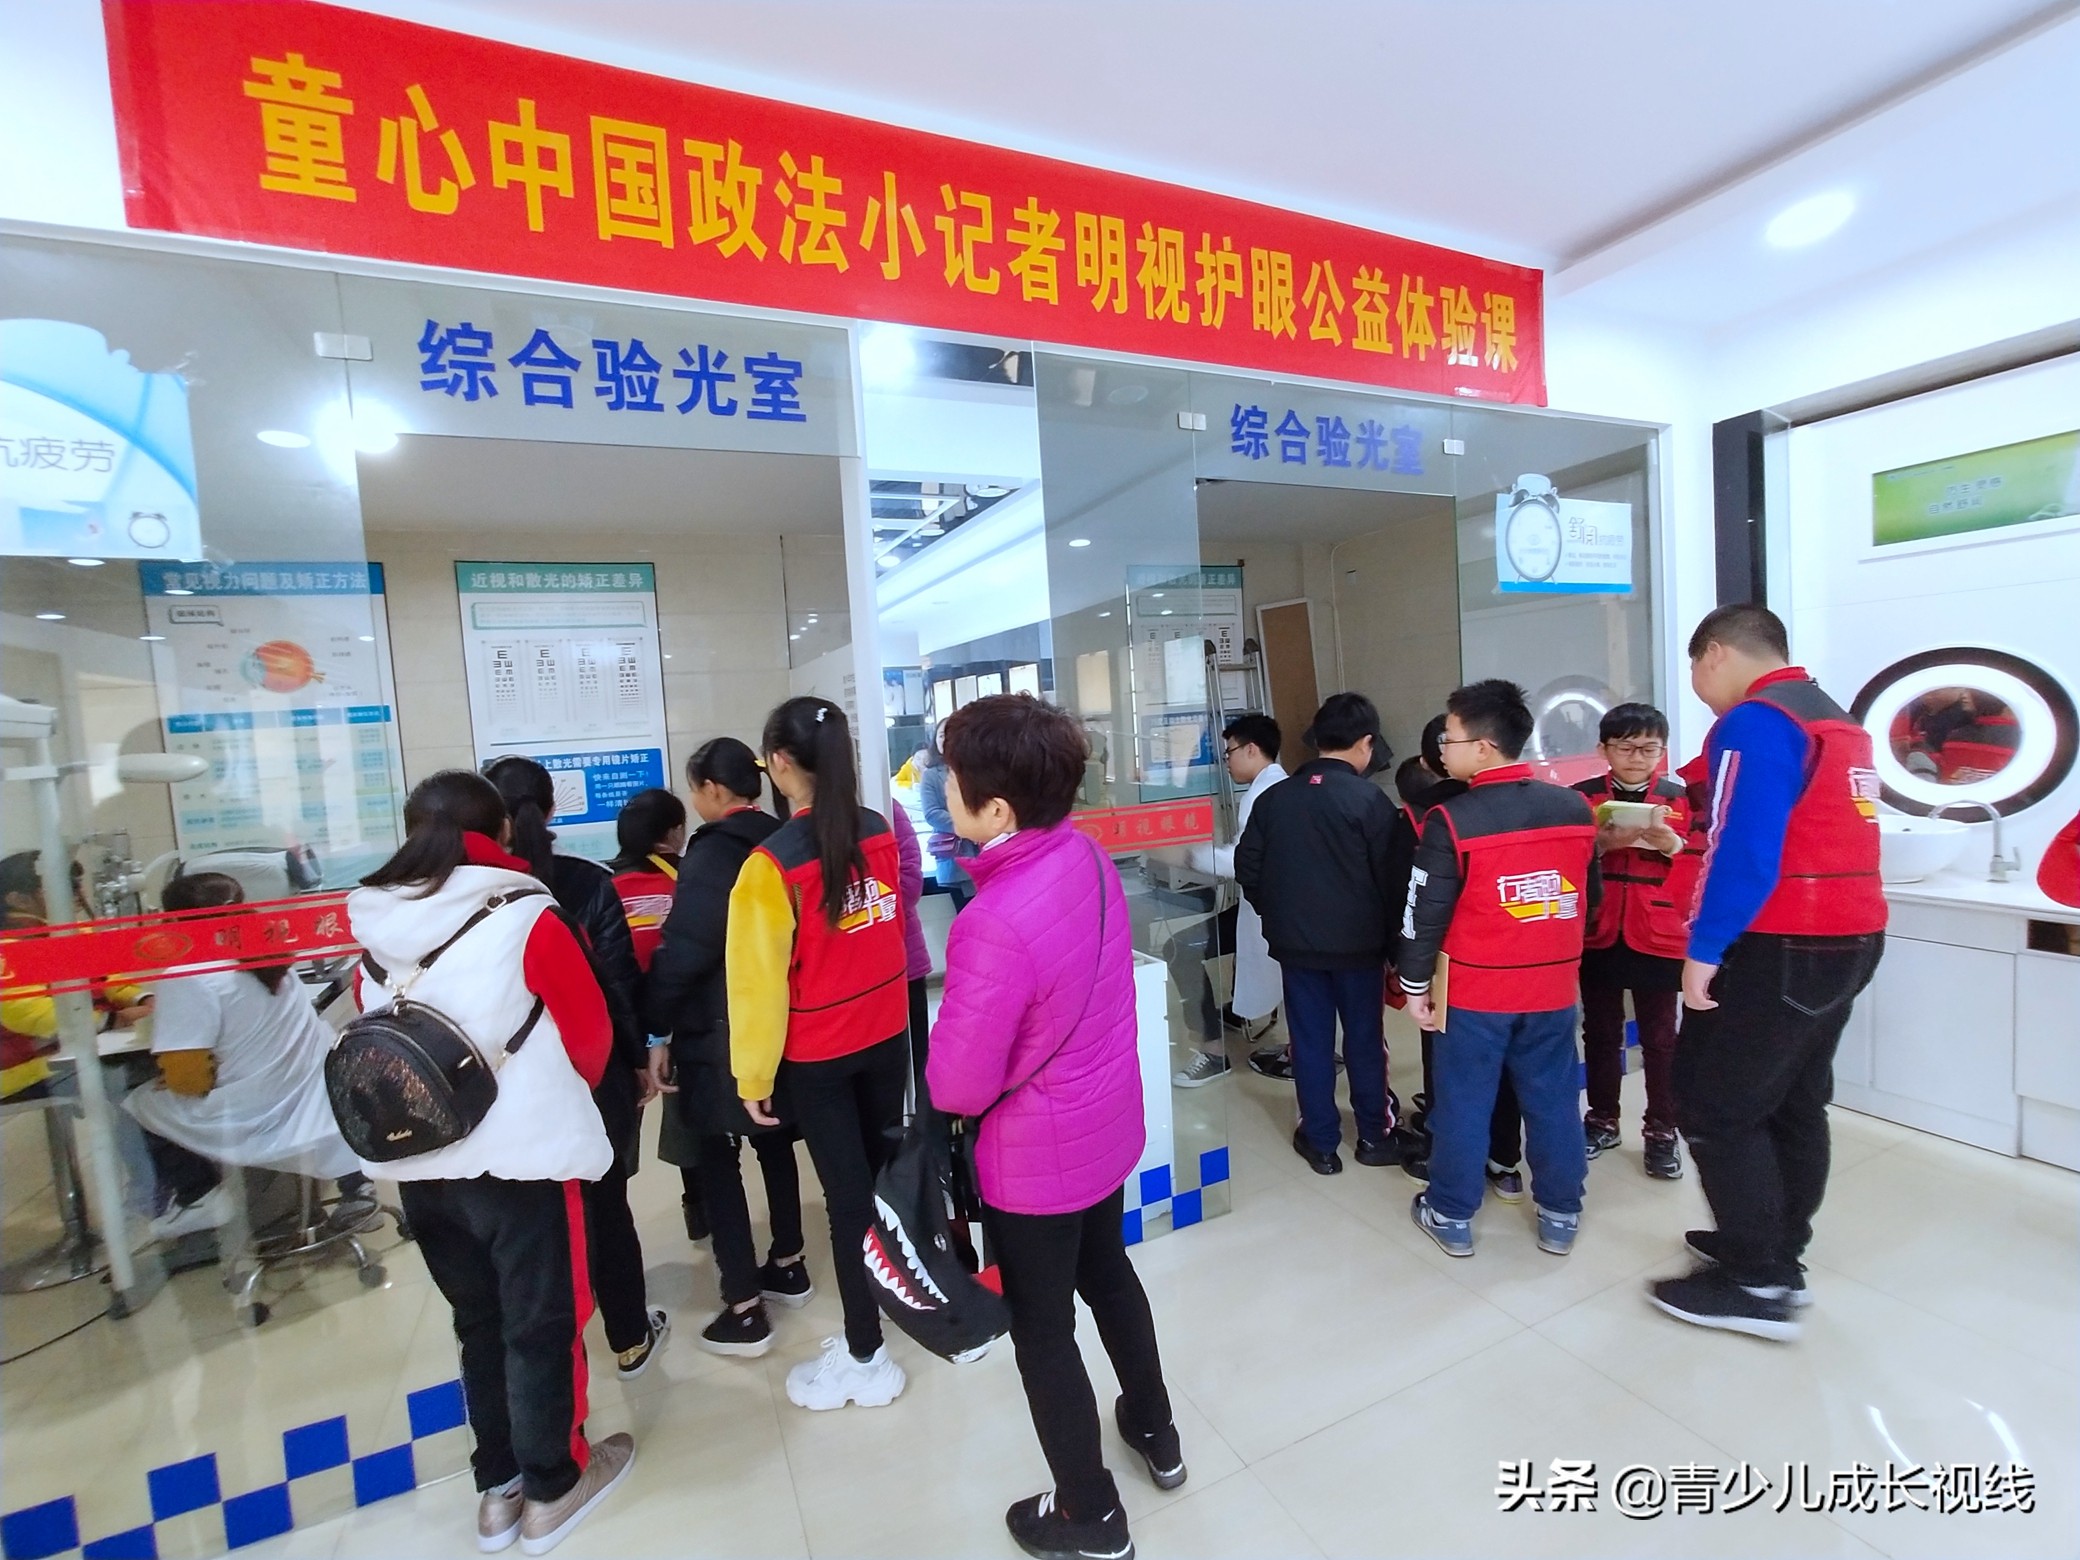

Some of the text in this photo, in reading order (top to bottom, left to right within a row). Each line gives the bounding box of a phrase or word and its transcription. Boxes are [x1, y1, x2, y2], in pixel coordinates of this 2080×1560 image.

[243, 52, 1520, 373] 童心中国政法小记者明视护眼公益体验课
[418, 318, 807, 423] 综合验光室
[1230, 403, 1425, 476] 综合验光室
[471, 572, 644, 590] 近视和散光的矫正差异
[537, 753, 650, 769] 上散光需要专用镜片矫正
